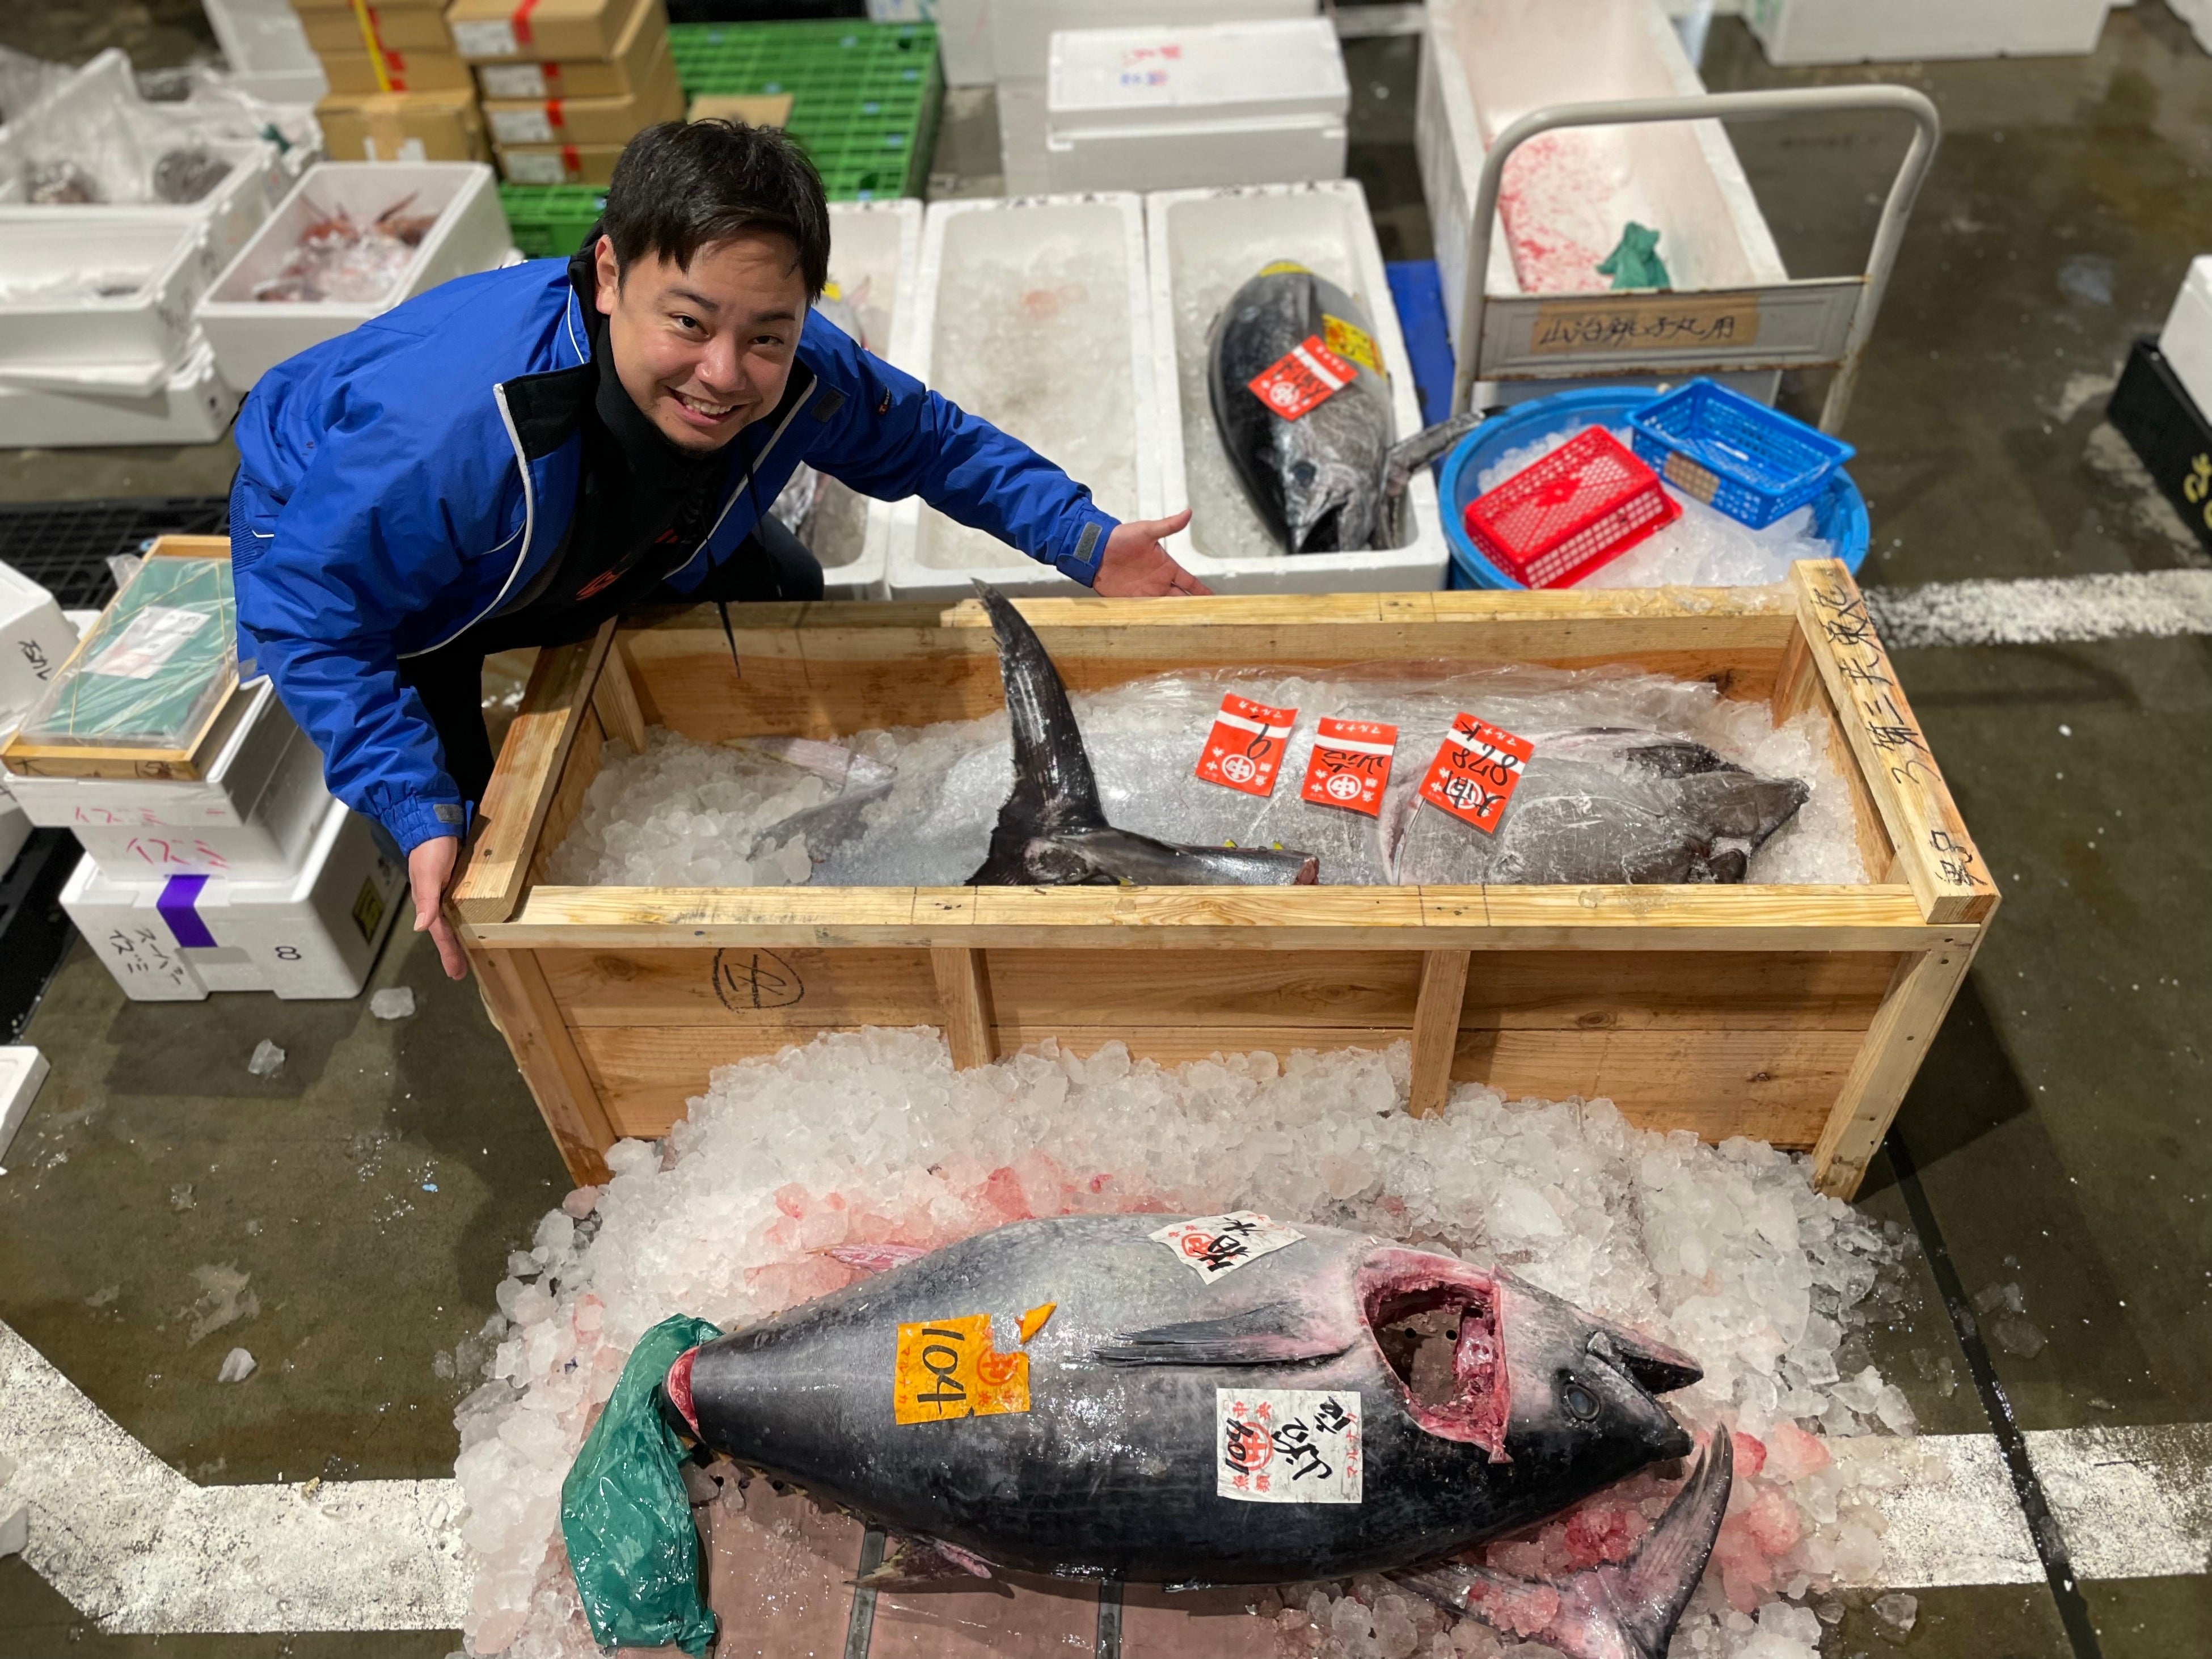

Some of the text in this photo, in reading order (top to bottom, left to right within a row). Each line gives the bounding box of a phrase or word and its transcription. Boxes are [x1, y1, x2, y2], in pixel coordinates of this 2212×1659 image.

[1238, 700, 1282, 719] マルナカ
[1335, 723, 1381, 734] マルナカ
[1206, 746, 1225, 771] 中央
[1315, 744, 1385, 775] 山治
[1311, 769, 1328, 792] 中央
[1442, 770, 1506, 817] 大間
[126, 838, 231, 869] イズミ
[275, 945, 302, 960] 8
[917, 1328, 966, 1416] 104
[1232, 1401, 1272, 1421] 中央
